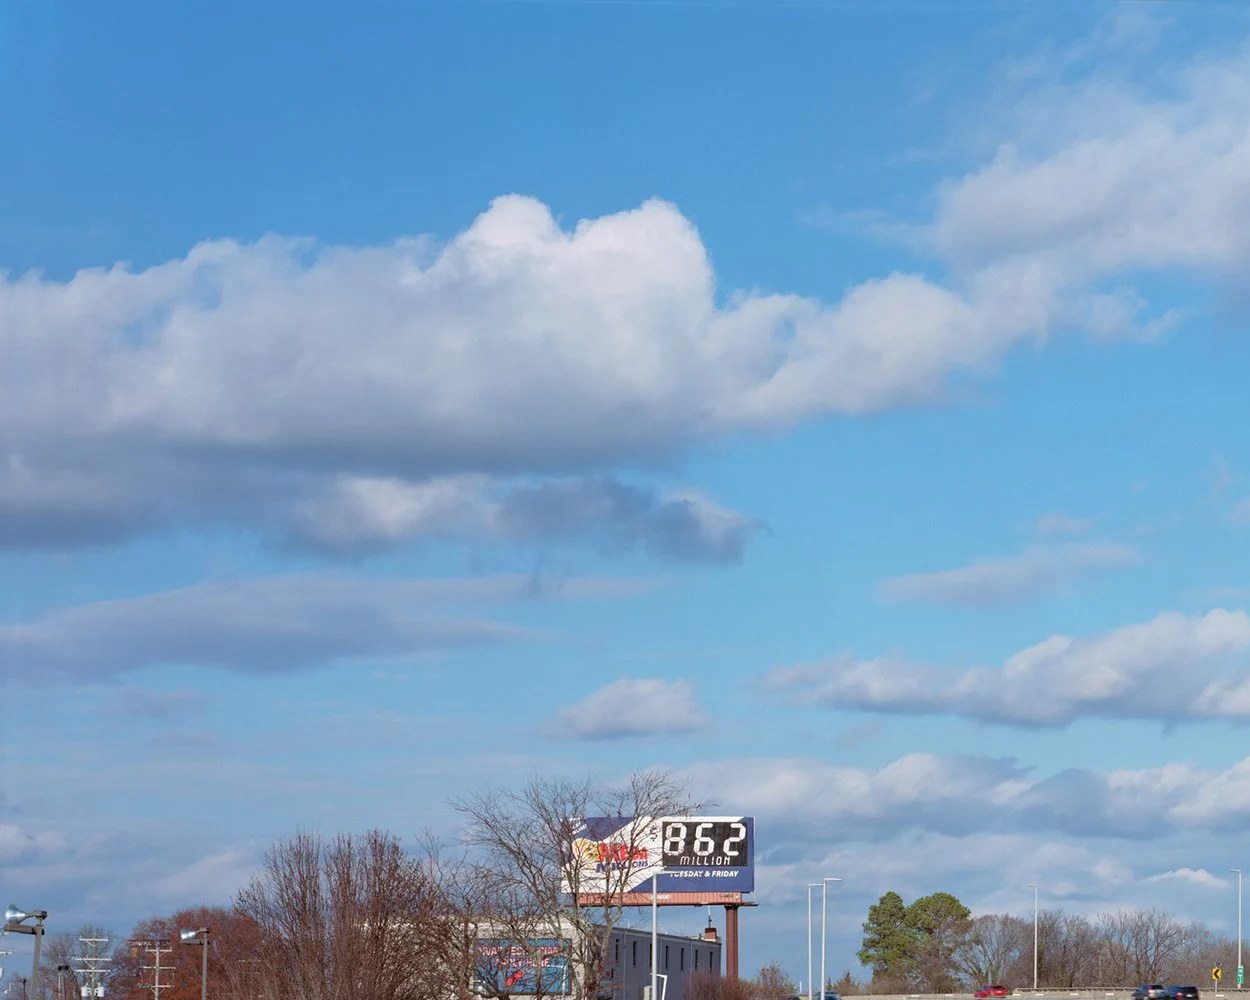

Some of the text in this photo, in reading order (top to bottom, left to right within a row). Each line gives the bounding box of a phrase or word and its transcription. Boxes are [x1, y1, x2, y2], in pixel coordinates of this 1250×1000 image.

[663, 823, 746, 856] 862
[680, 856, 731, 865] MILLION
[711, 870, 739, 878] FRIDAY
